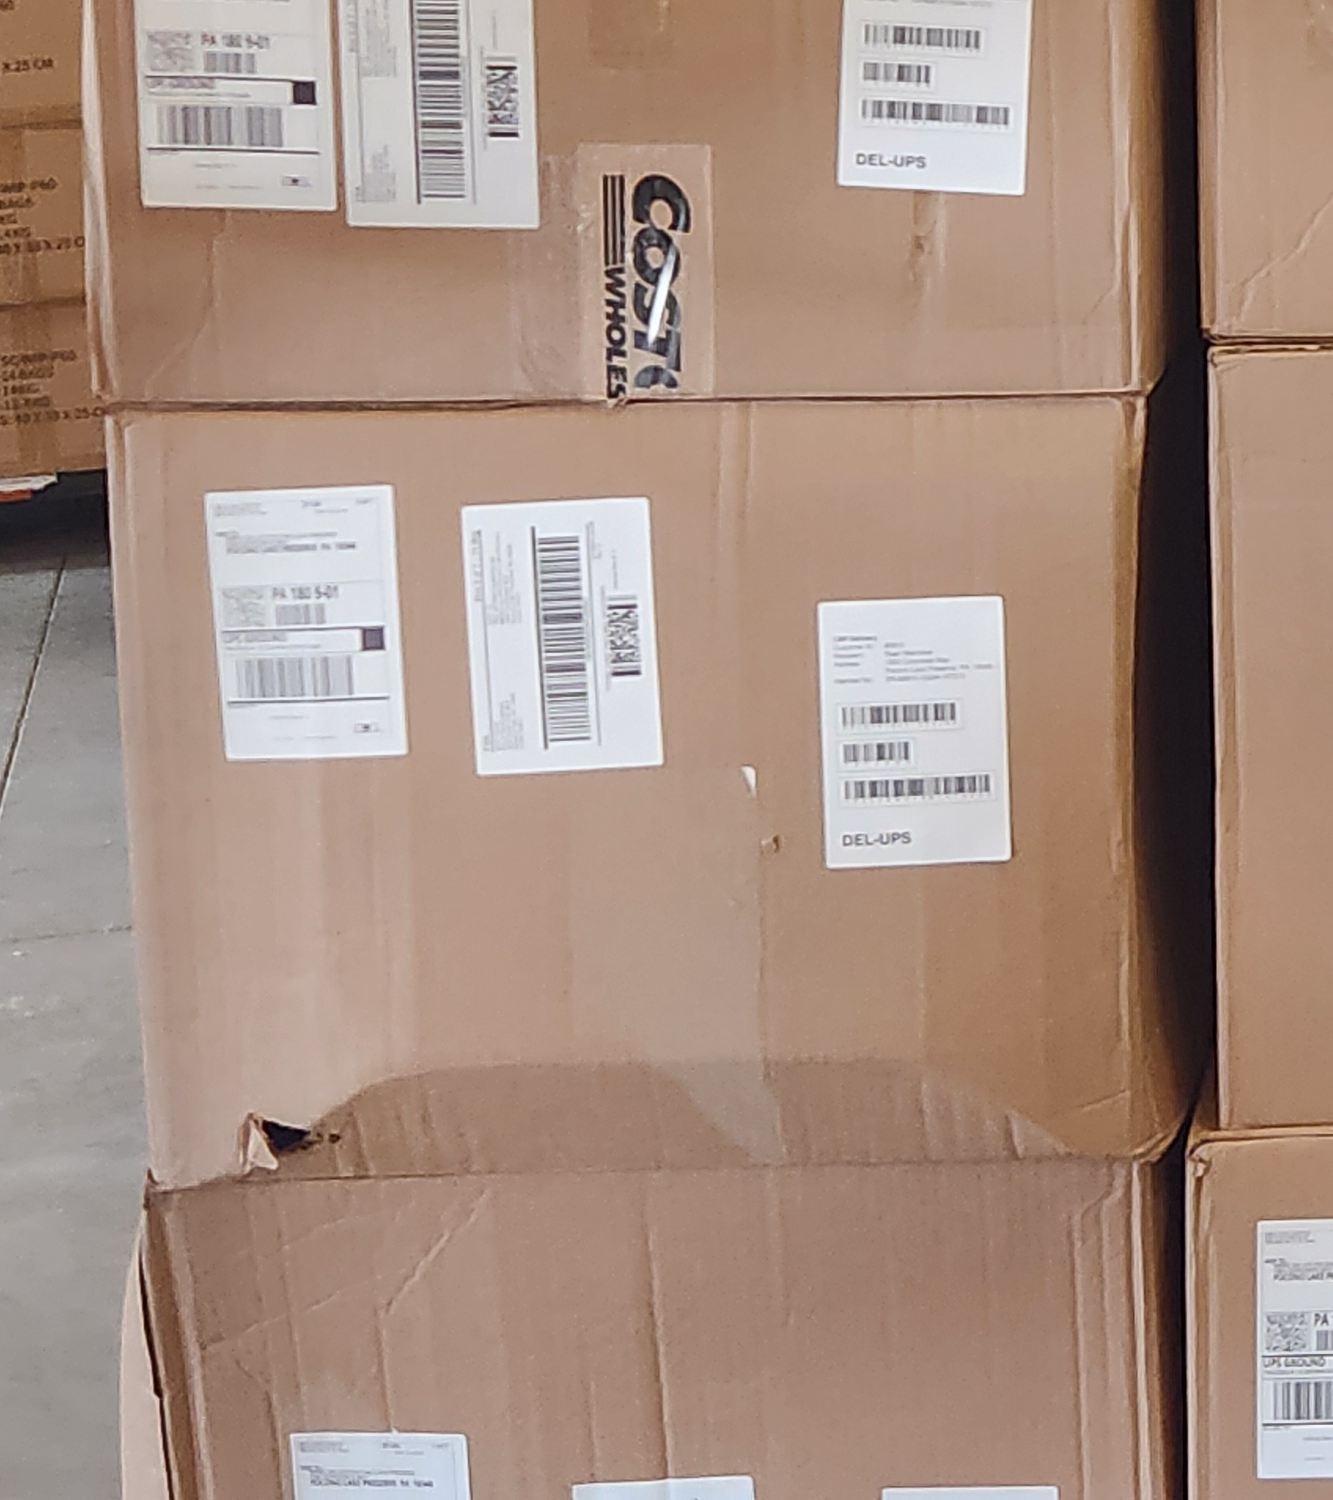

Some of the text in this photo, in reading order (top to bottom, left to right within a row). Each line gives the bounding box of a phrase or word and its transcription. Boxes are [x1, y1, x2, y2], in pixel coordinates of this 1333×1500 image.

[855, 152, 927, 168] DEL-UPS
[842, 831, 912, 846] DEL-UPS
[1314, 1312, 1329, 1325] PA
